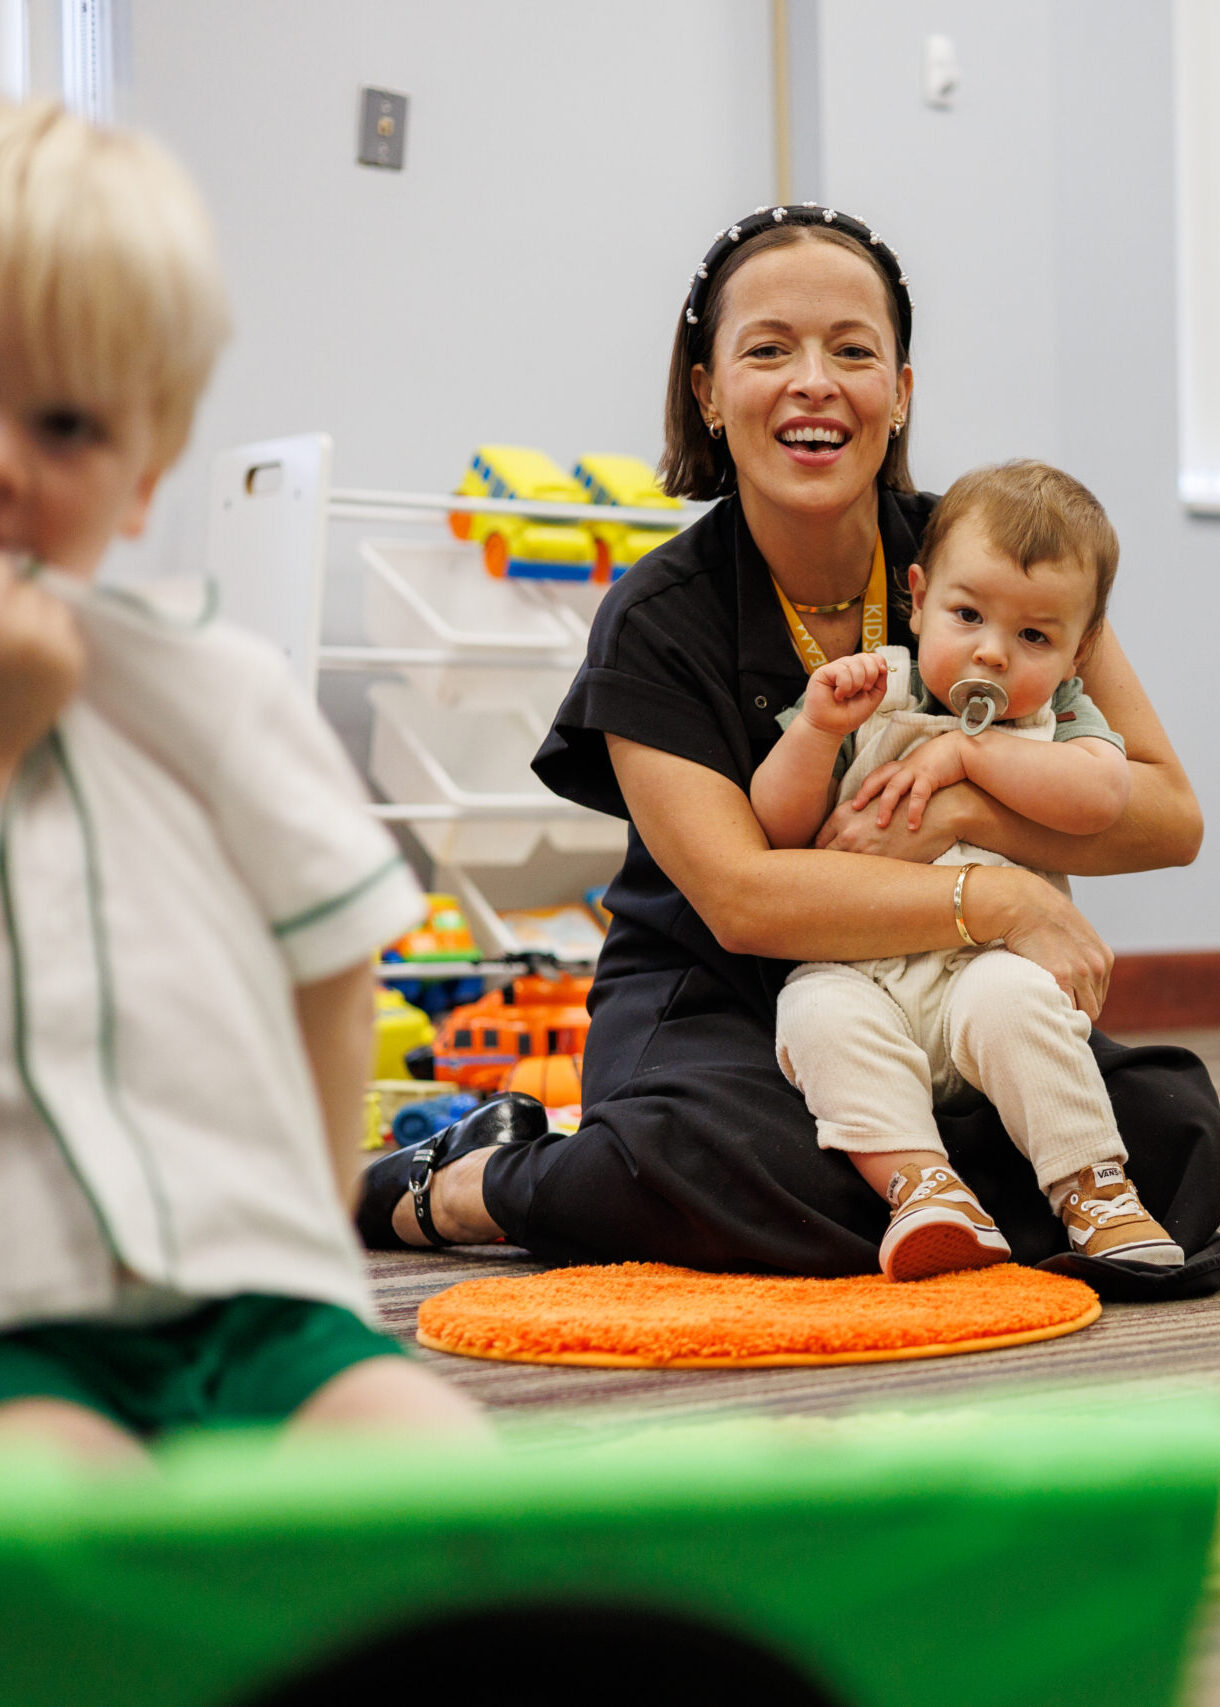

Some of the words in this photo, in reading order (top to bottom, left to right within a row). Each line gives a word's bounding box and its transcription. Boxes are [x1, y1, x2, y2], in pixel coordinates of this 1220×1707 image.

[796, 624, 827, 669] EAM
[864, 604, 882, 652] KIDS
[1097, 1167, 1119, 1178] VANS
